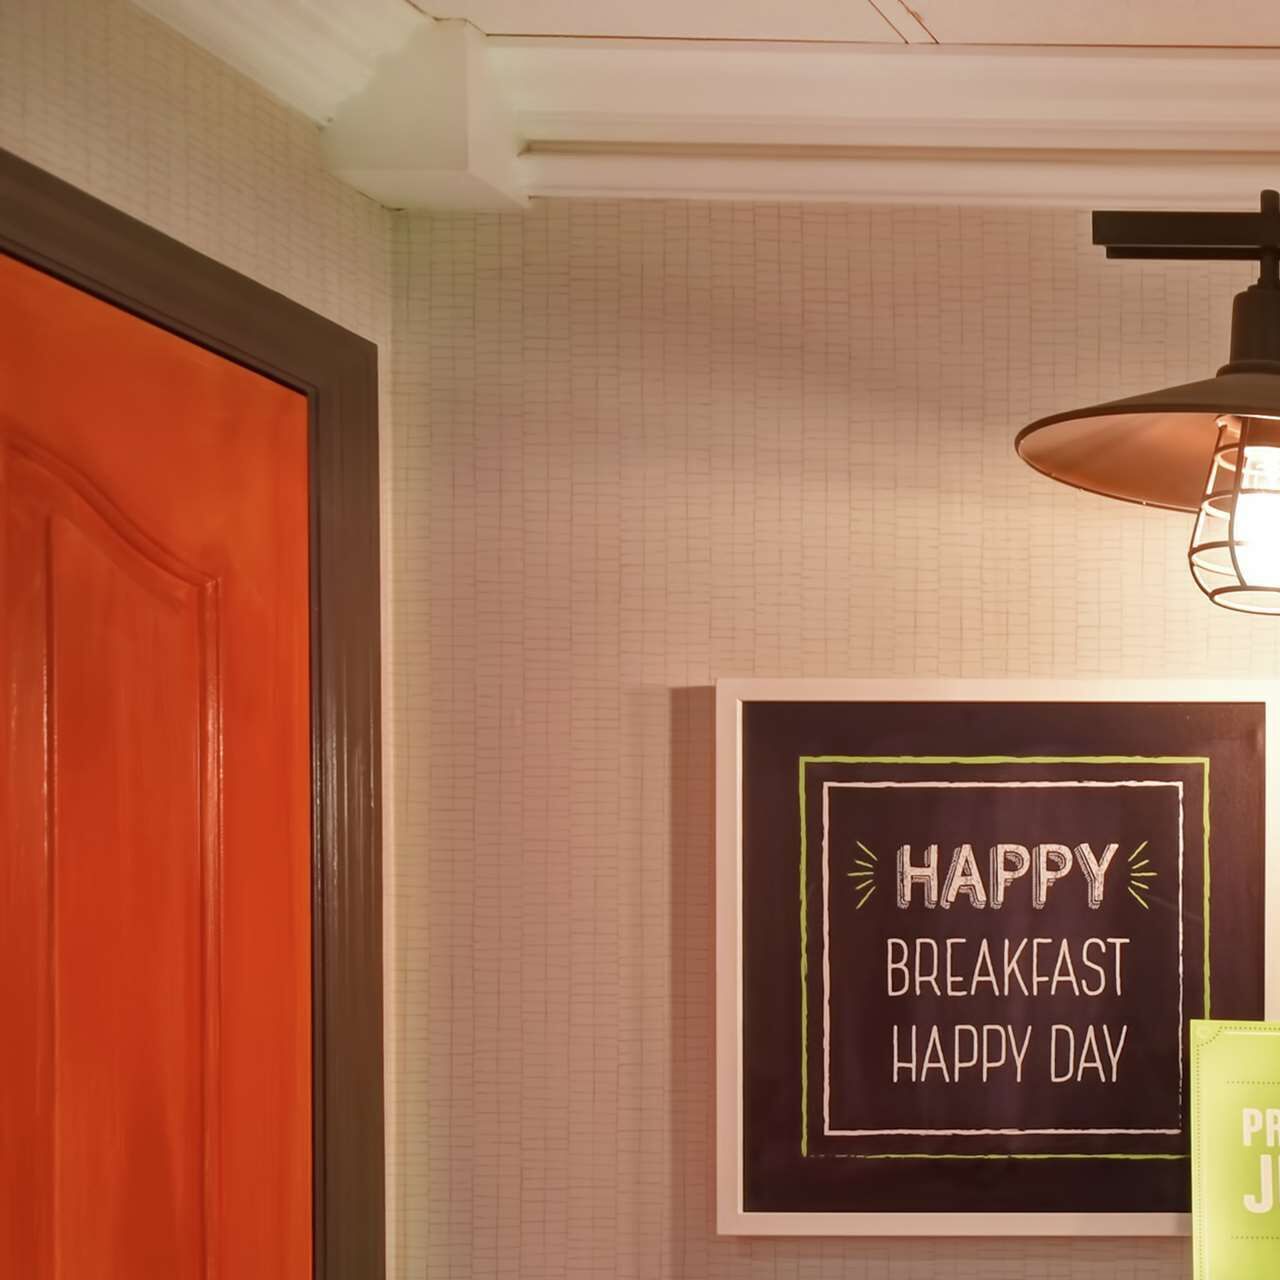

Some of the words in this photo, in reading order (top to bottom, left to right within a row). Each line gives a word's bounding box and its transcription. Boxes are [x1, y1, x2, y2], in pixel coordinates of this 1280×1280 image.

[896, 843, 1119, 909] HAPPY
[887, 938, 1130, 996] BREAKFAST
[893, 1025, 1032, 1083] HAPPY
[1050, 1025, 1128, 1083] DAY
